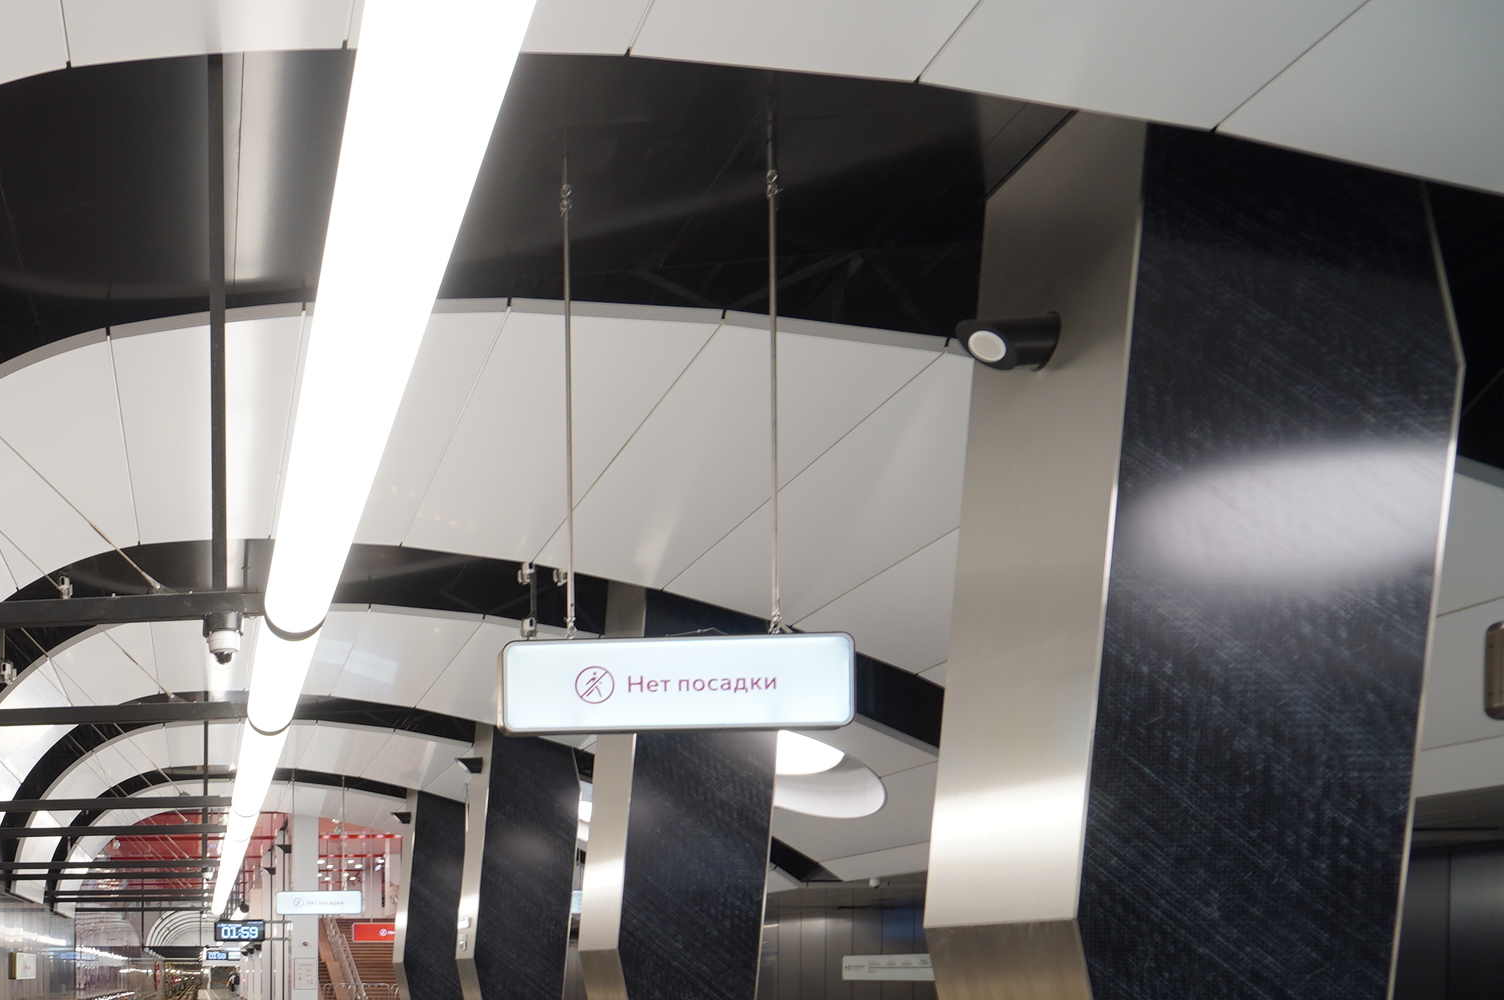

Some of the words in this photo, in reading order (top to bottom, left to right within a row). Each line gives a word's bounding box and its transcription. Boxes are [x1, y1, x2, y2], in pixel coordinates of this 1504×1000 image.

[627, 675, 671, 693] Нет
[678, 676, 778, 694] посадки
[221, 926, 259, 939] 01:59
